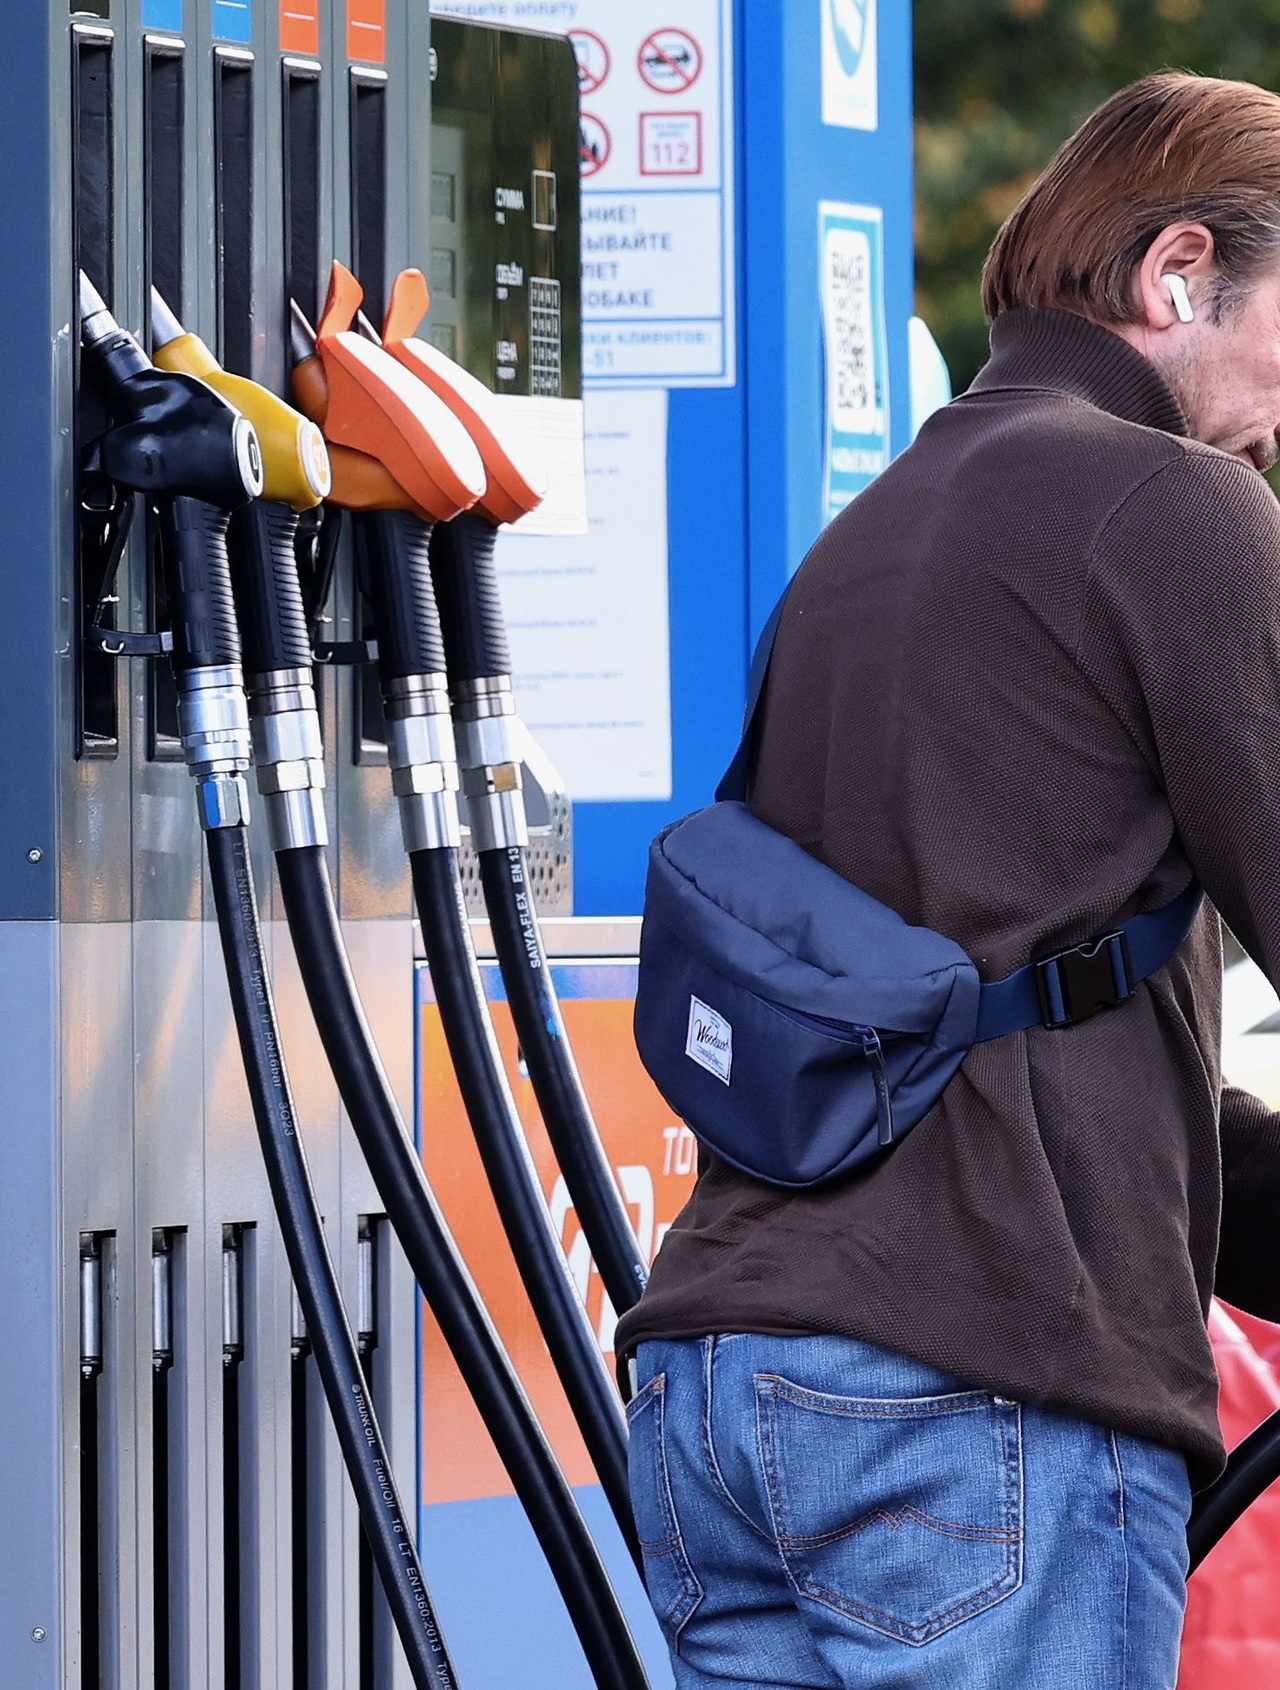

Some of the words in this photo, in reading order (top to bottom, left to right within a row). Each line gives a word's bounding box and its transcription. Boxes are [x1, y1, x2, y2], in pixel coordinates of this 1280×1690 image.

[652, 142, 690, 165] 112
[510, 863, 523, 884] EN
[515, 893, 541, 968] SAIYA-FLEX
[264, 1031, 282, 1087] PN16bar
[278, 1101, 294, 1136] 3Q23
[391, 1518, 404, 1533] 16
[398, 1542, 412, 1558] LT
[406, 1566, 442, 1653] EN1360:2013
